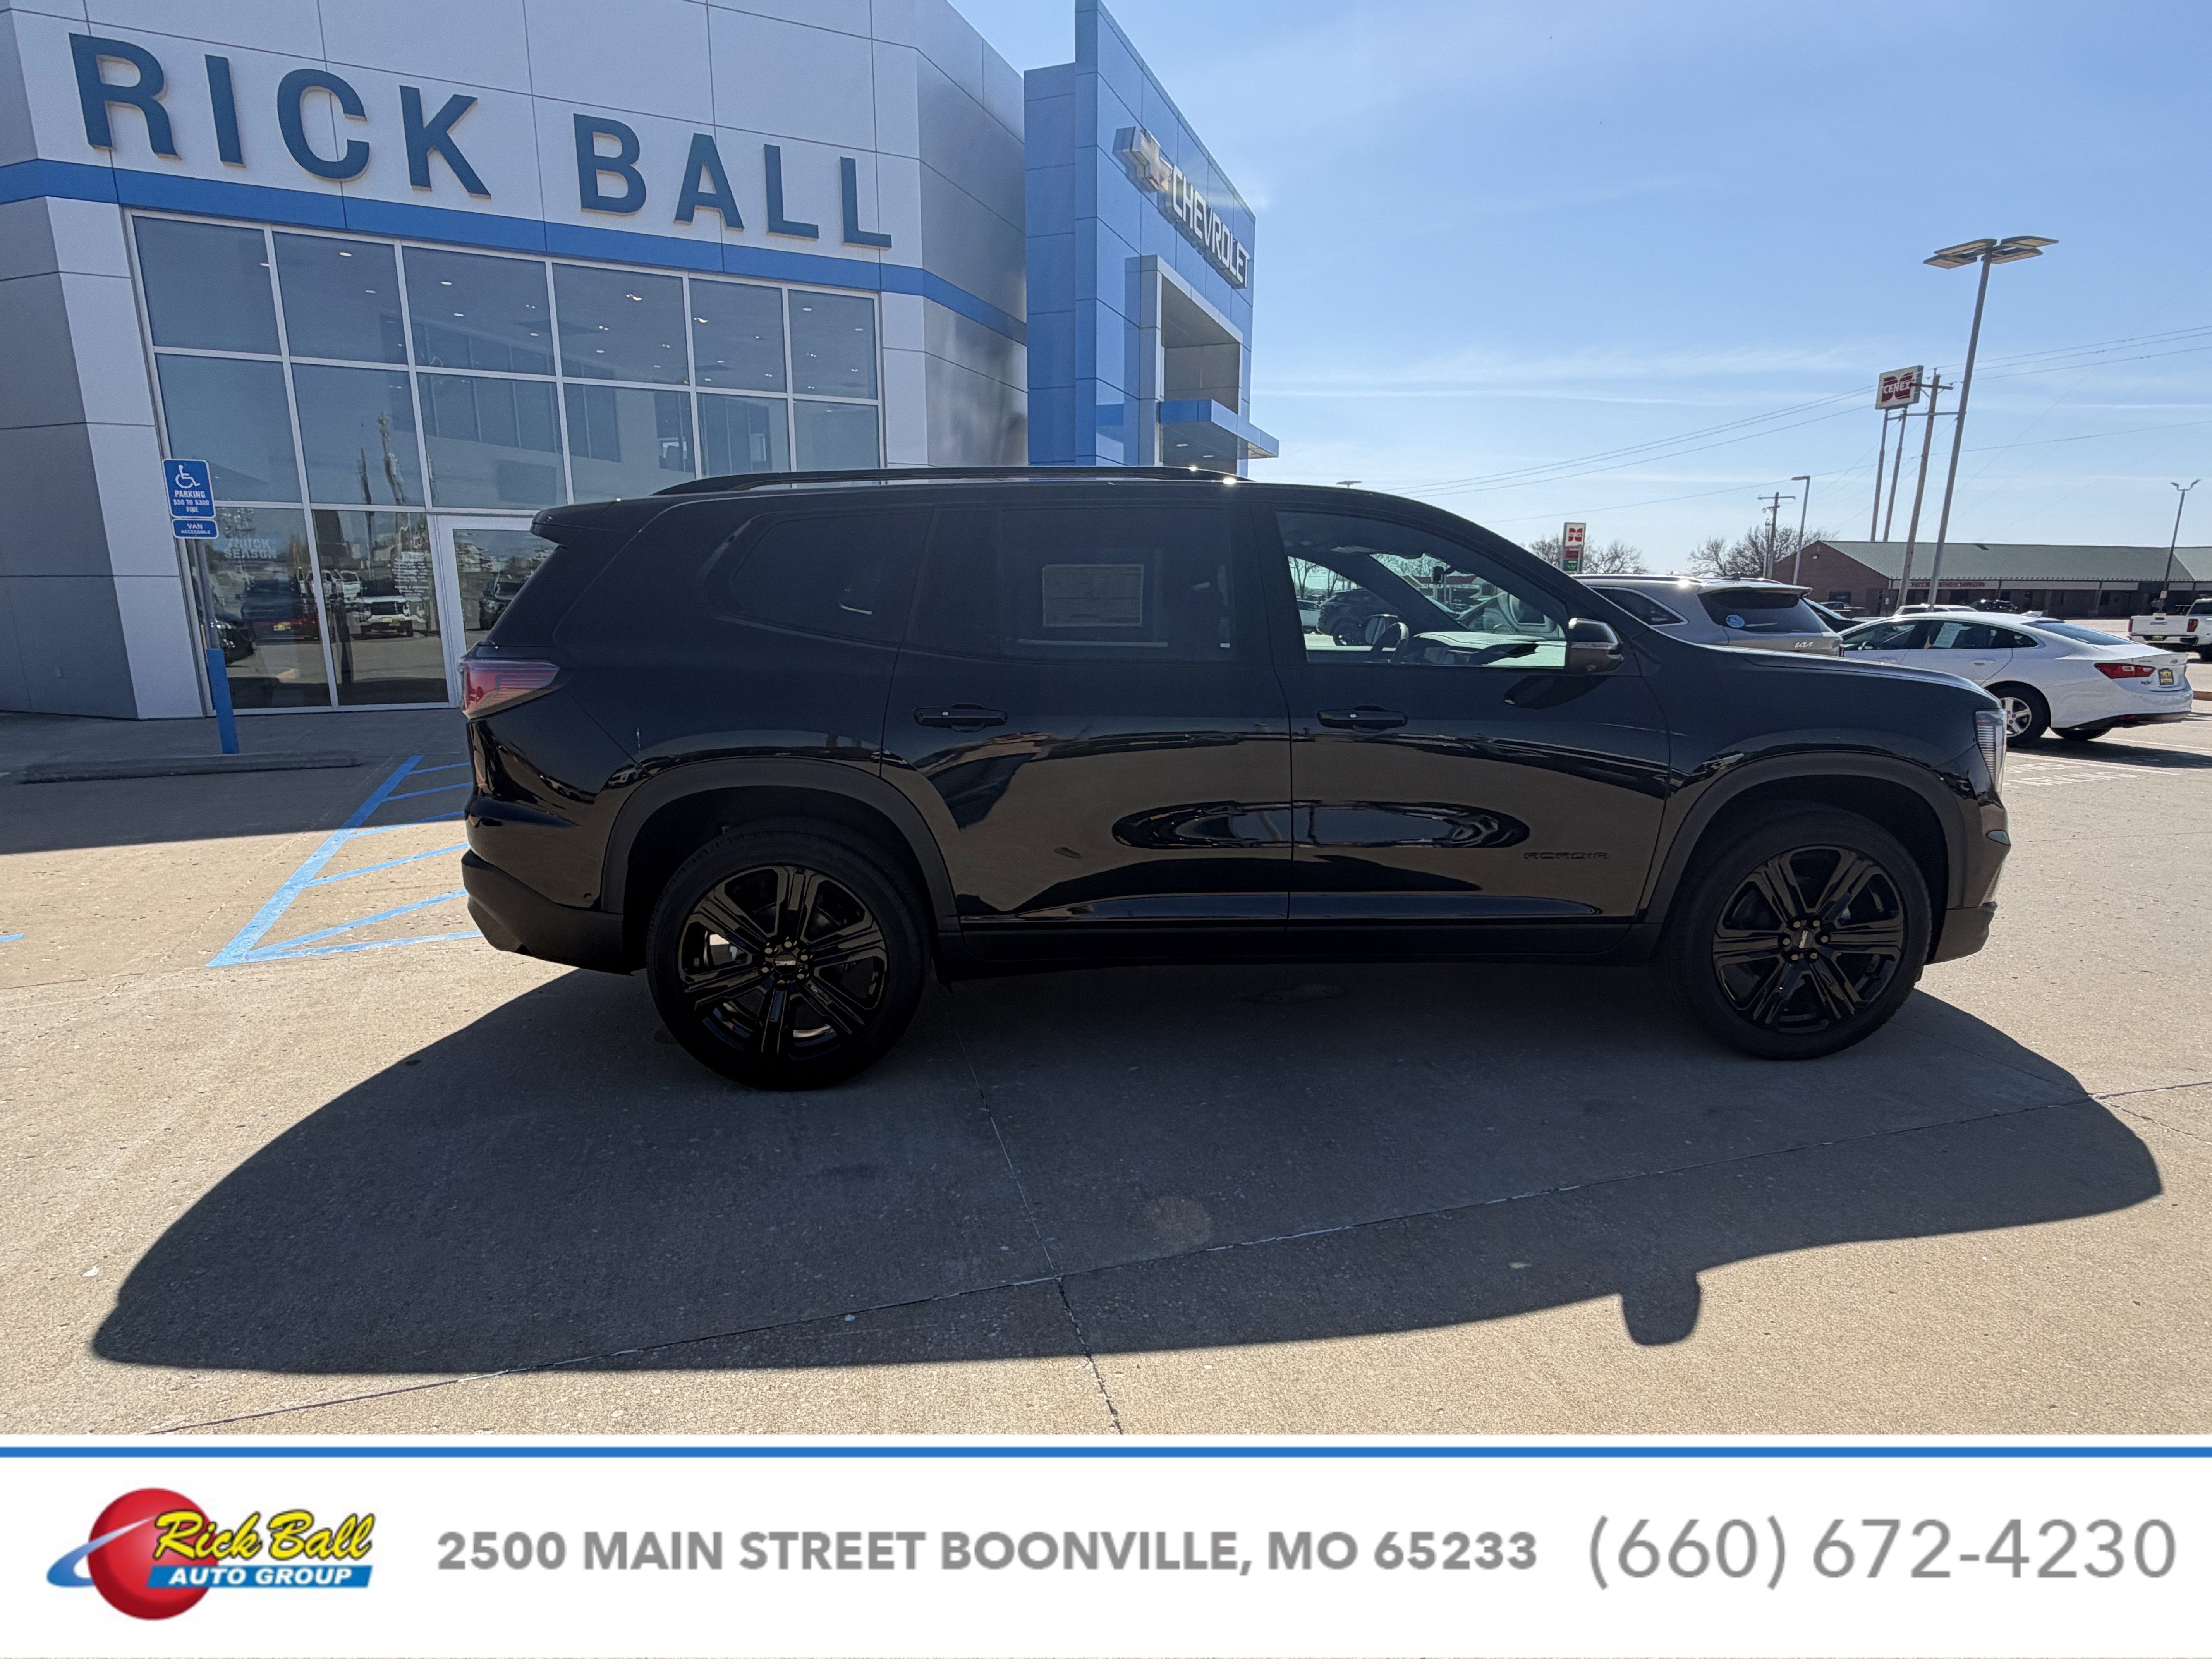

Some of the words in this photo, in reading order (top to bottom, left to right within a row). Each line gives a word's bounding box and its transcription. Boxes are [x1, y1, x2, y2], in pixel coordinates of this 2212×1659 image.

[69, 33, 491, 199] RICK
[573, 113, 892, 249] BALL
[1173, 165, 1250, 289] CHEVROLET
[174, 490, 206, 498] PARKING
[224, 548, 278, 559] SEASON
